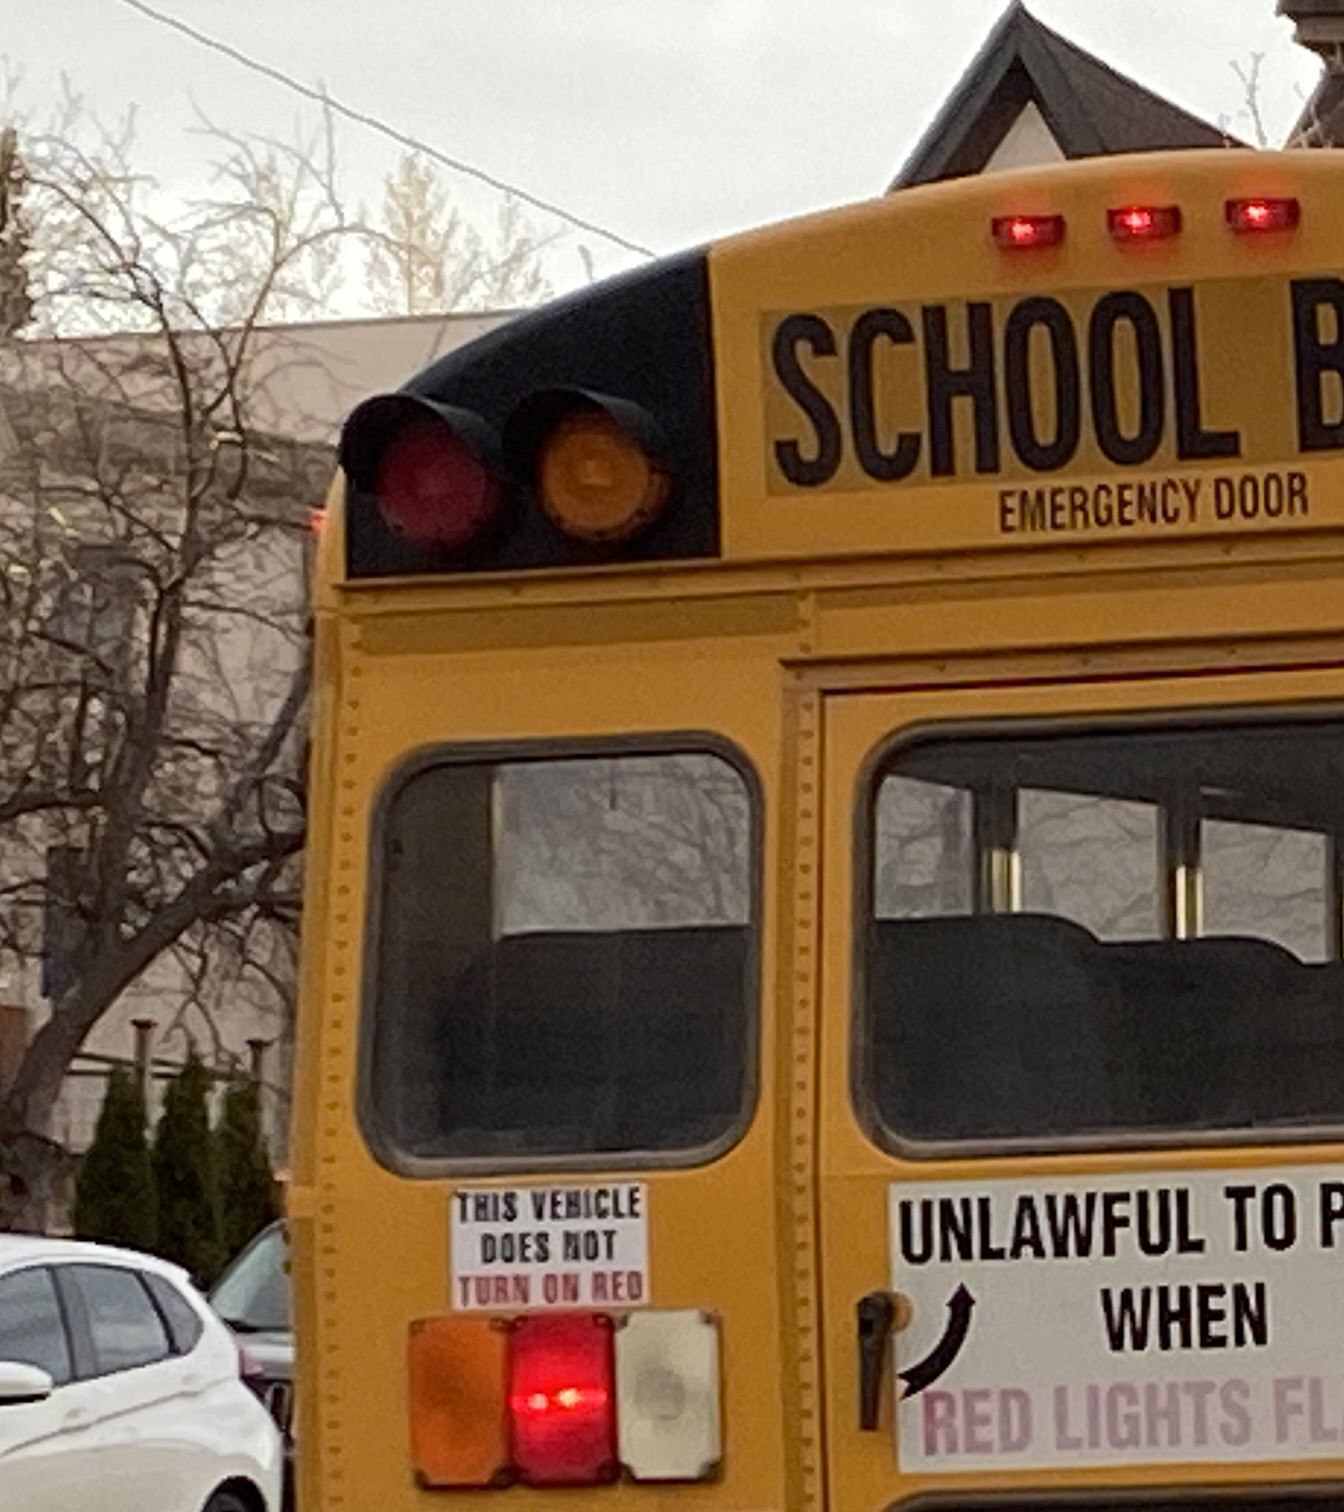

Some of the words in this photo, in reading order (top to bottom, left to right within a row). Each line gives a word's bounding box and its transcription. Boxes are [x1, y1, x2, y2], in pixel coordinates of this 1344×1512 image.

[772, 286, 1241, 489] SCHOOL
[999, 478, 1200, 533] EMERGENCY
[1214, 472, 1308, 520] DOOR
[457, 1191, 518, 1223] THIS
[531, 1186, 640, 1222] VEHICLE
[899, 1187, 1205, 1265] UNLAWFUL
[1225, 1183, 1296, 1252] TO
[481, 1231, 550, 1265] DOES
[563, 1229, 617, 1262] NOT
[458, 1274, 531, 1306] TURN
[543, 1272, 580, 1304] ON
[591, 1270, 643, 1302] RED
[1101, 1281, 1269, 1352] WHEN
[922, 1387, 1031, 1457] RED
[1054, 1378, 1252, 1452] LIGHTS
